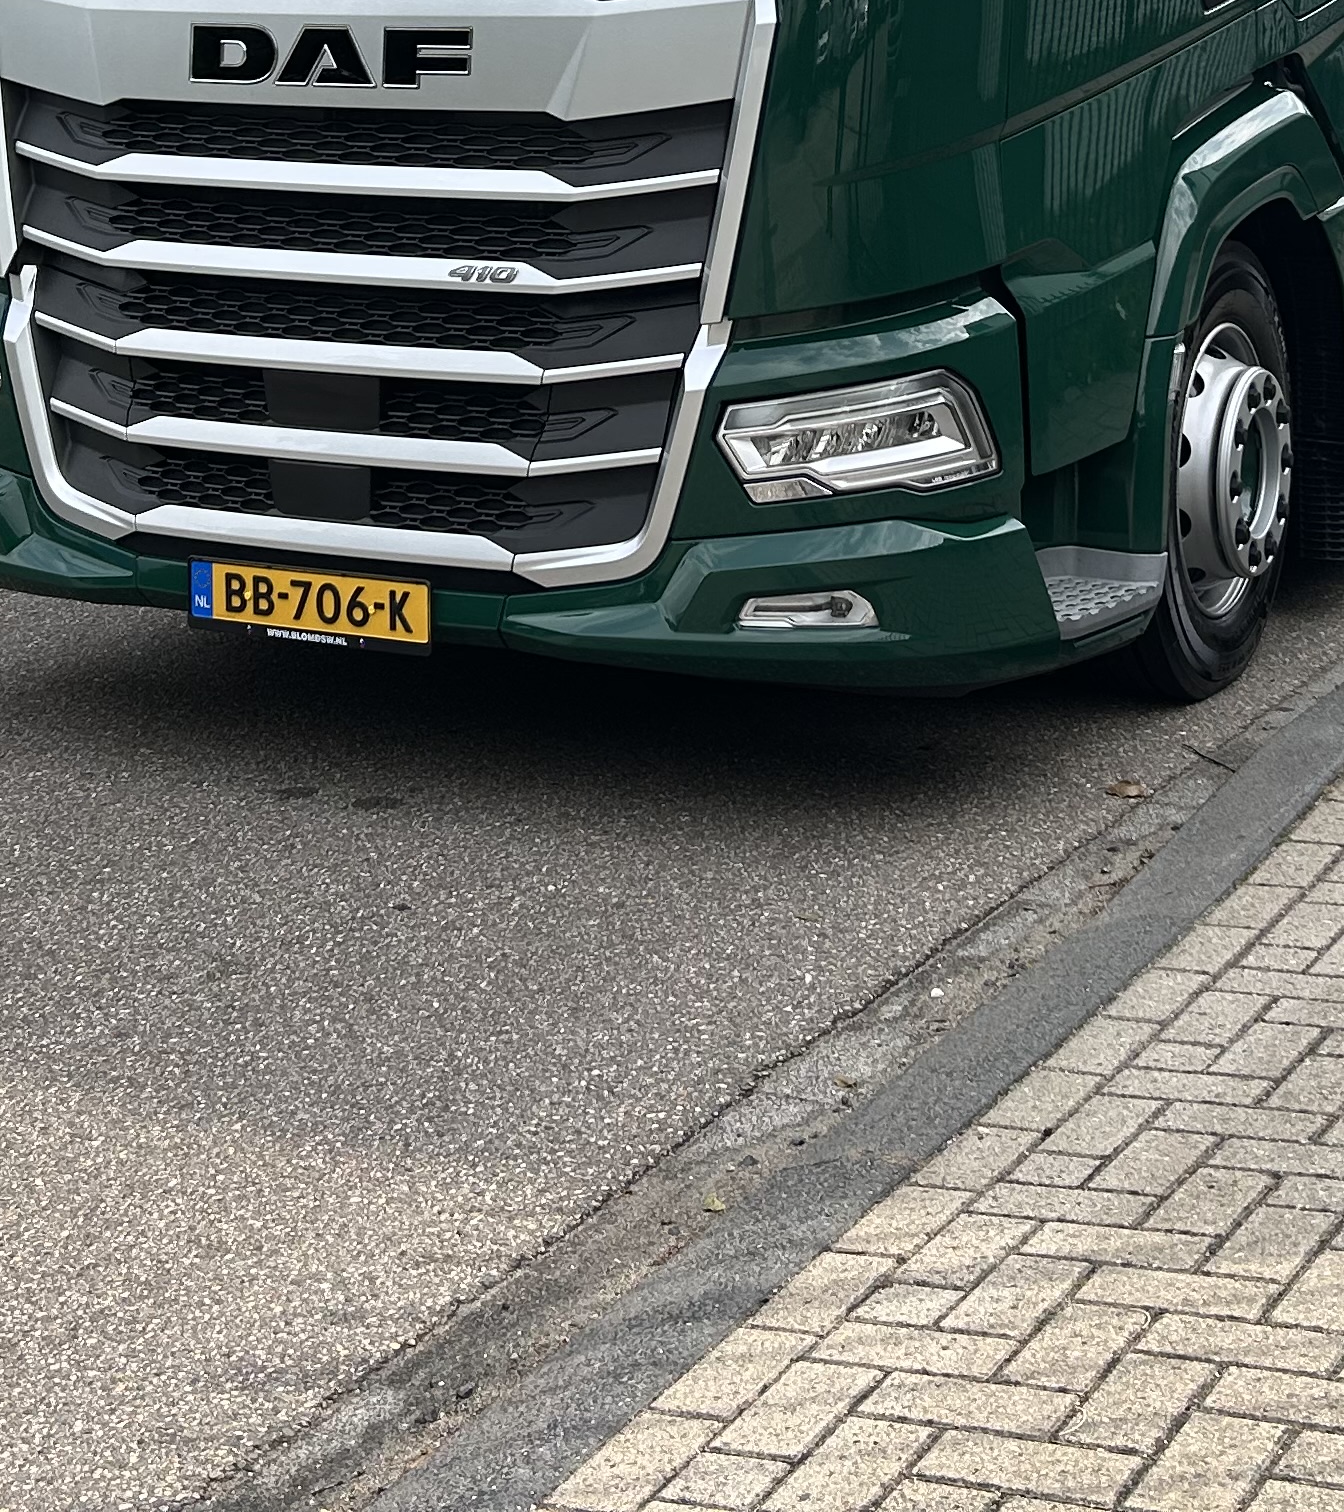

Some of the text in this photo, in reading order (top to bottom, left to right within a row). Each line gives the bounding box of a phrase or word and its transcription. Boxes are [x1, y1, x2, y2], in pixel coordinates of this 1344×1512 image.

[189, 22, 474, 89] DAF
[448, 264, 519, 283] 410
[194, 593, 211, 609] NL
[224, 571, 414, 634] BB-706-K
